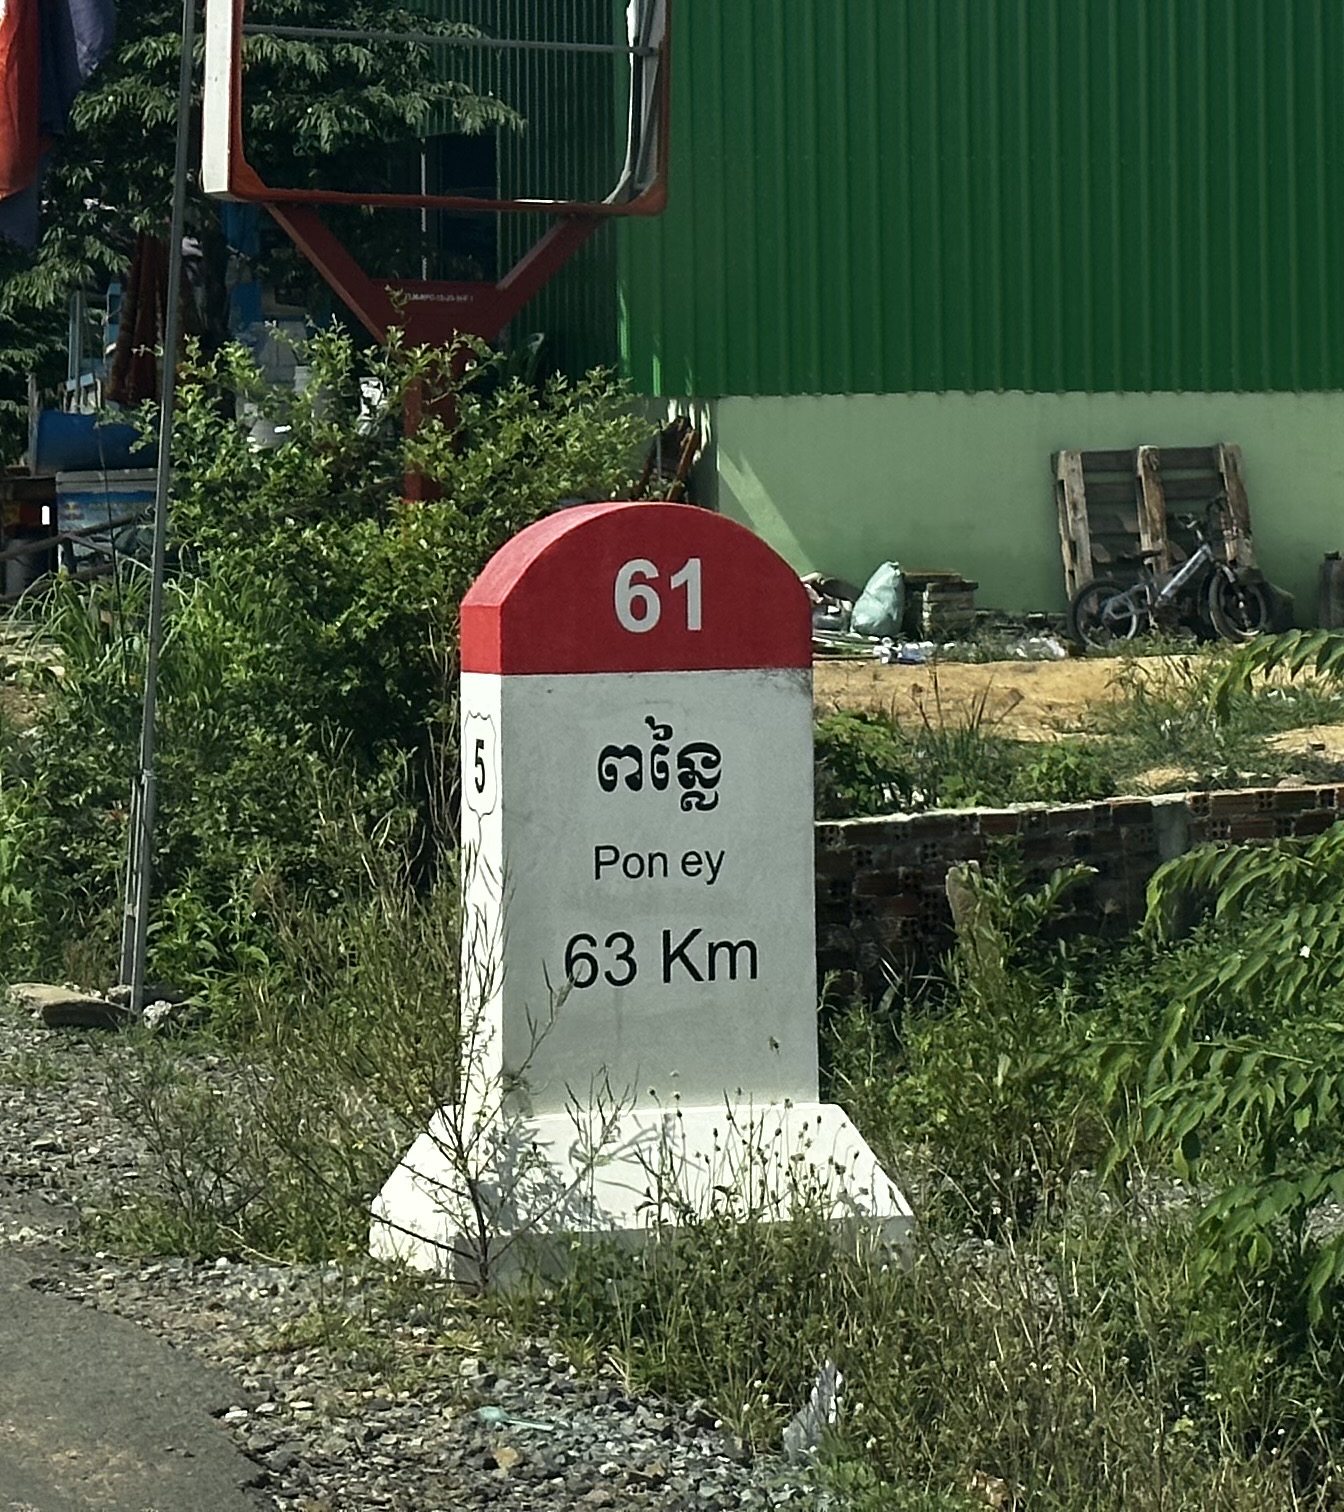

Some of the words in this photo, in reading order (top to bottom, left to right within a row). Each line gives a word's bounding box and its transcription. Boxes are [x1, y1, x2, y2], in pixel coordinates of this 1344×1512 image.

[613, 556, 703, 634] 61
[474, 738, 486, 794] 5
[597, 714, 723, 813] ពន្លៃ
[564, 931, 638, 989] 63
[661, 927, 759, 986] Km
